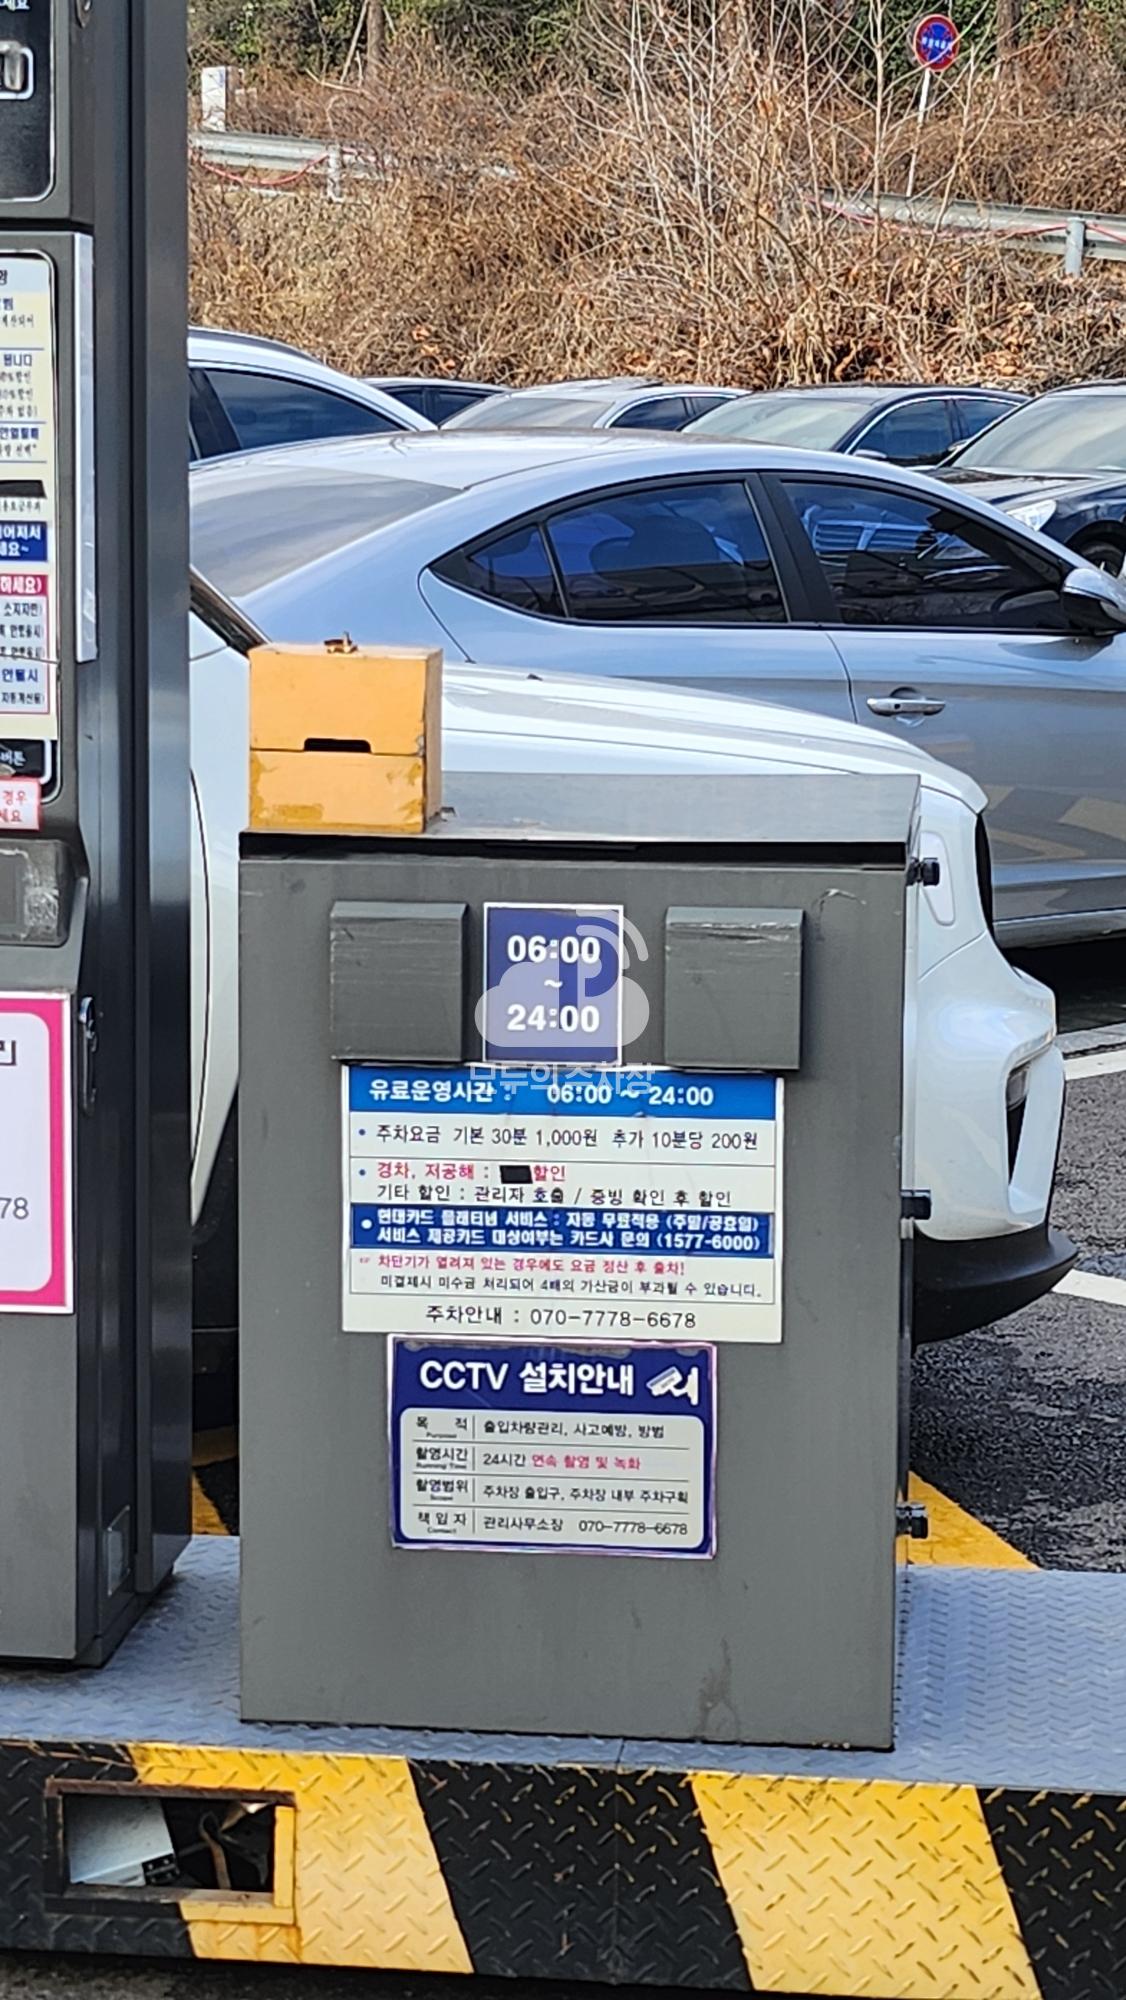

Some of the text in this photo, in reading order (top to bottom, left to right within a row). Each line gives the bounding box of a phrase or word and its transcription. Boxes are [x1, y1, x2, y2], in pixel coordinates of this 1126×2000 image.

[3, 790, 27, 805] 경우
[507, 935, 600, 963] 06:00
[507, 1004, 599, 1032] 24:00
[369, 1079, 496, 1103] 유료운영시간
[547, 1084, 612, 1104] 06:00
[648, 1086, 714, 1106] 24:00
[376, 1125, 757, 1150] 주차요금 기본 30분 1,000원 추가 10분당 200원
[377, 1162, 415, 1179] 경차,
[425, 1163, 474, 1180] 저공해
[377, 1185, 409, 1200] 기타
[419, 1186, 450, 1201] 할인
[474, 1186, 524, 1202] 관리자
[532, 1187, 564, 1203] 호출
[590, 1188, 623, 1205] 증빙
[633, 1189, 664, 1206] 확인
[673, 1190, 689, 1207] 후
[699, 1191, 731, 1207] 할인
[377, 1208, 434, 1225] 현대카드
[505, 1212, 548, 1226] 서비스
[566, 1213, 595, 1228] 자동
[377, 1229, 420, 1243] 서비스
[428, 1230, 485, 1244] 제공카드
[570, 1231, 614, 1246] 카드사
[621, 1233, 649, 1248] 문의
[657, 1233, 760, 1250] (1577-6000)
[378, 1255, 429, 1269] 차단기가
[481, 1257, 505, 1271] 있는
[571, 1259, 595, 1273] 요금
[603, 1260, 628, 1273] 정산
[634, 1262, 647, 1274] 후
[381, 1275, 431, 1289] 미결제시
[439, 1276, 475, 1289] 미수금
[483, 1278, 534, 1291] 처리되어
[581, 1280, 633, 1294] 가산금이
[685, 1283, 697, 1295] 수
[704, 1283, 762, 1298] 있습니다.
[426, 1305, 502, 1324] 주차안내
[530, 1309, 696, 1329] 070-7778-6678
[420, 1360, 634, 1396] CCTV 설치안내
[416, 1447, 641, 1469] 촬영시간 24시간 연속 촬영 및 녹화
[416, 1479, 467, 1492] 촬영범위
[483, 1486, 519, 1499] 주차장
[570, 1488, 606, 1501] 주차장
[612, 1489, 634, 1502] 내부
[484, 1516, 563, 1532] 관리사무소장
[579, 1521, 687, 1535] 070-7778-6678
